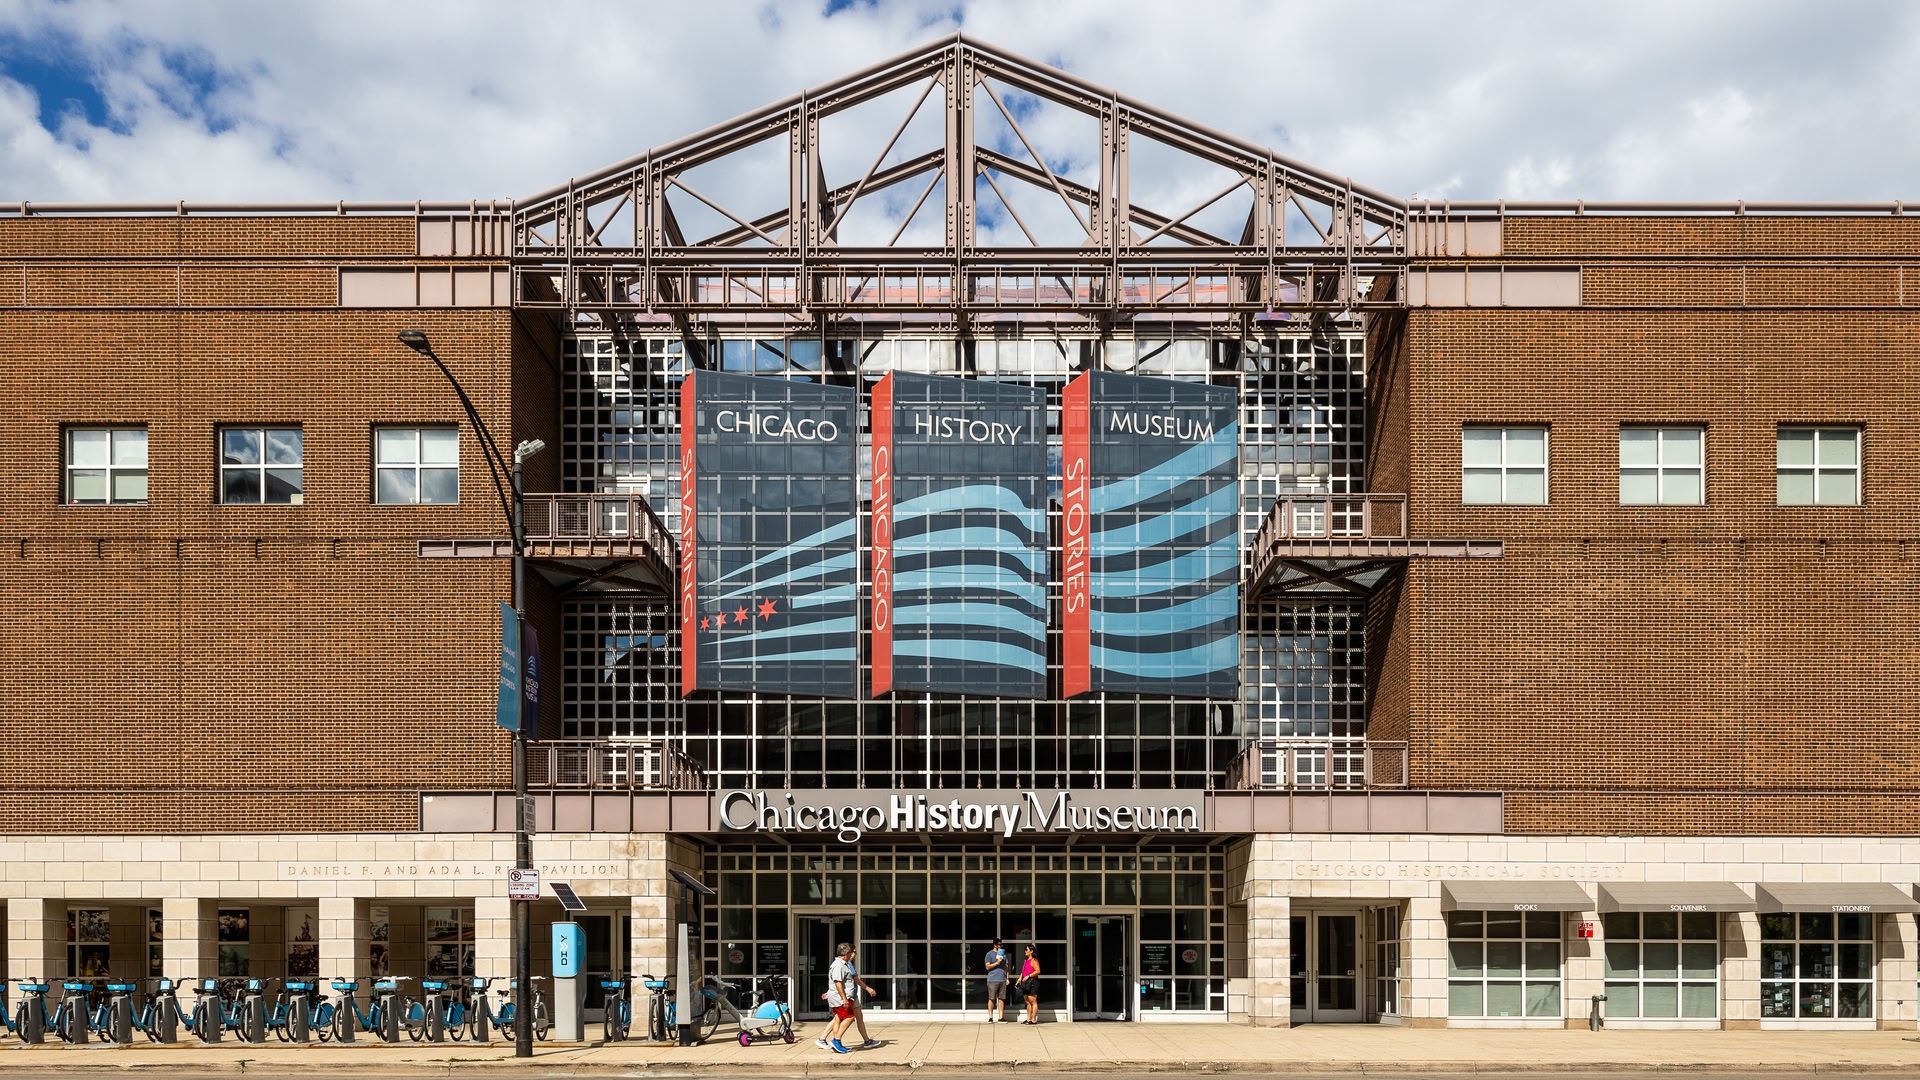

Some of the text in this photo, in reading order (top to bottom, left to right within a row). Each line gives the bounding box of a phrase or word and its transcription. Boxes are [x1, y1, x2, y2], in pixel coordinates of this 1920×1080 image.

[716, 410, 1215, 445] CHICAGO HISTORY MUSEUM
[682, 446, 1084, 631] SHARING CHICAGO STORIES
[718, 790, 1200, 843] Chicago History Museum
[287, 866, 351, 876] DANIEL
[362, 866, 373, 876] F.
[384, 866, 418, 876] AND
[428, 866, 462, 876] ADA
[473, 866, 485, 876] L.
[542, 866, 619, 876] PAVILION
[1295, 864, 1625, 878] CHICAGO HISTORICAL SOCIETY
